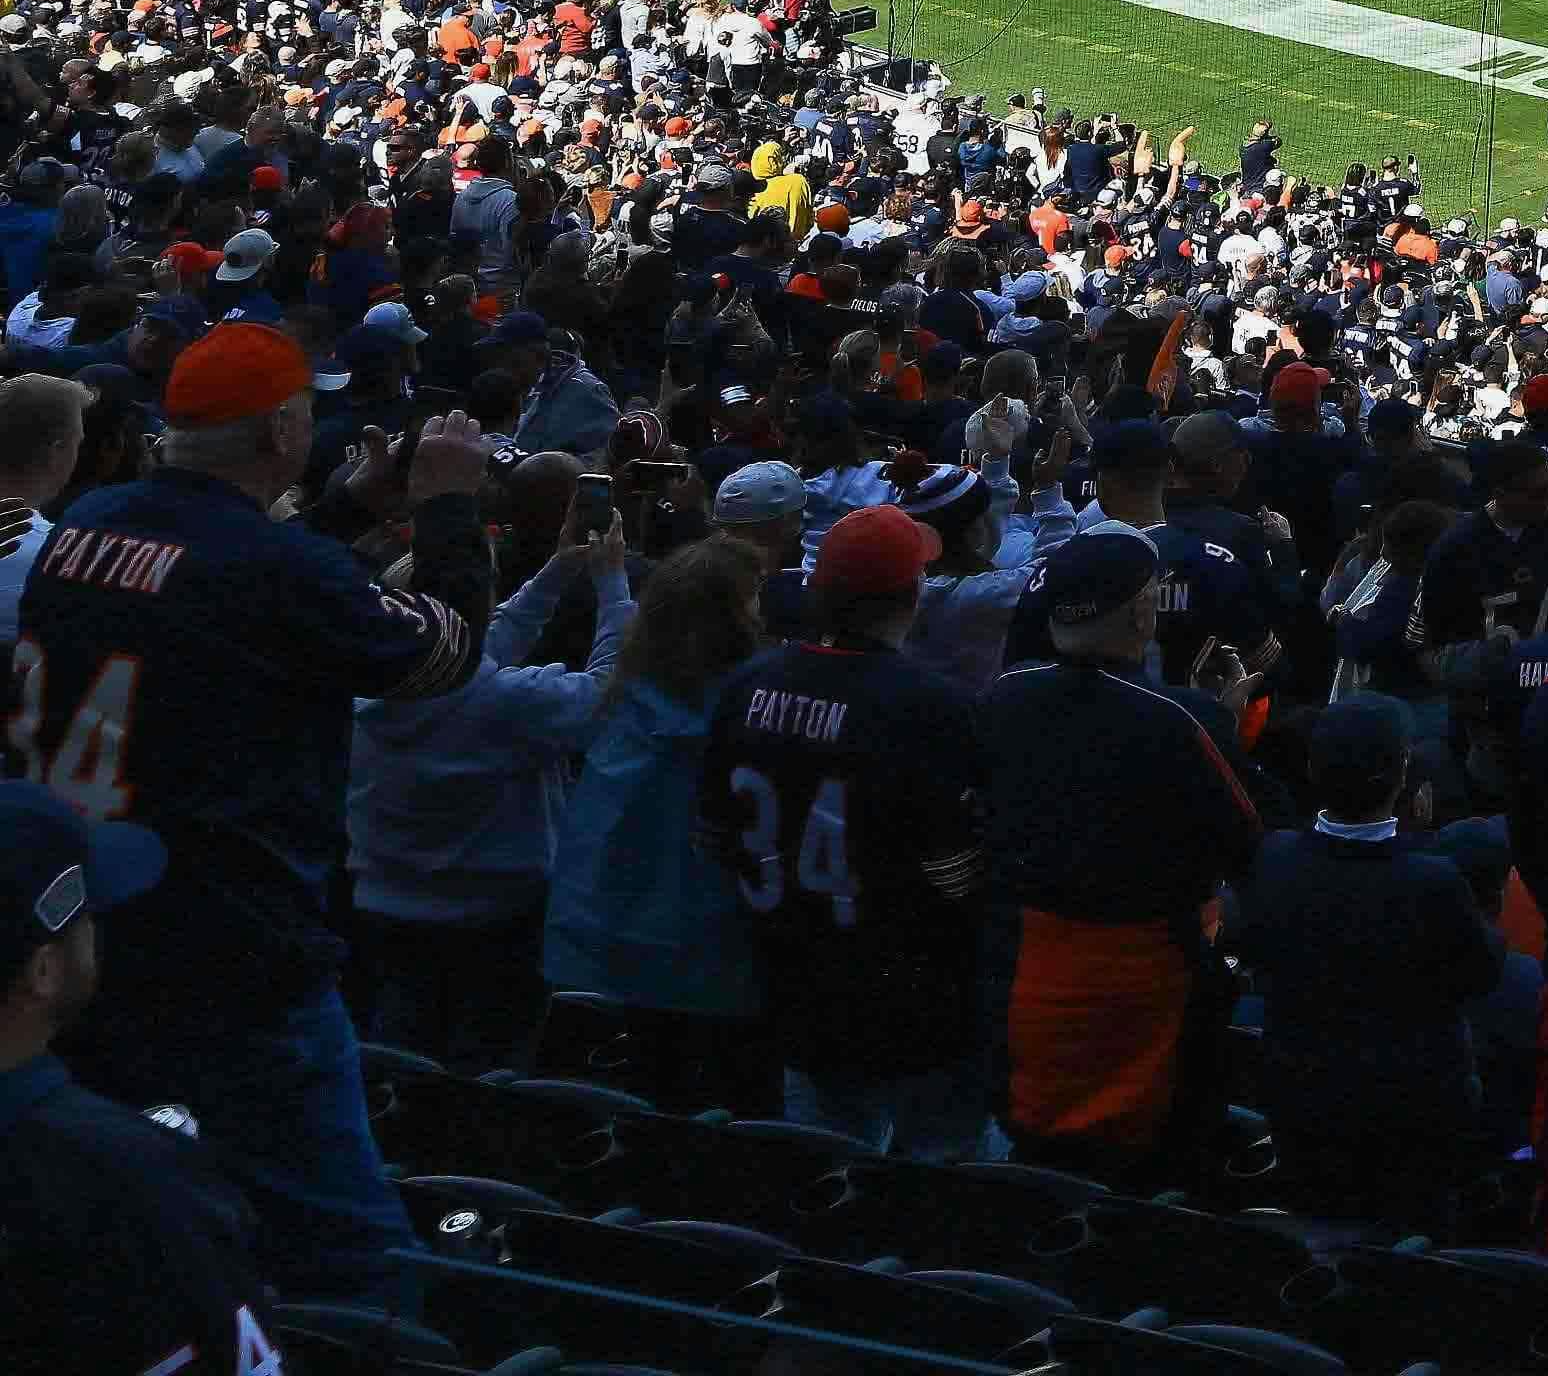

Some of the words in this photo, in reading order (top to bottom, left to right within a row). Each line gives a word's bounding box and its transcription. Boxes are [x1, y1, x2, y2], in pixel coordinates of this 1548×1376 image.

[896, 134, 918, 154] 58
[849, 298, 878, 312] FIELDS
[40, 525, 184, 595] PAYTON
[6, 638, 142, 821] 34
[745, 686, 849, 743] PAYTON
[729, 763, 859, 928] 34
